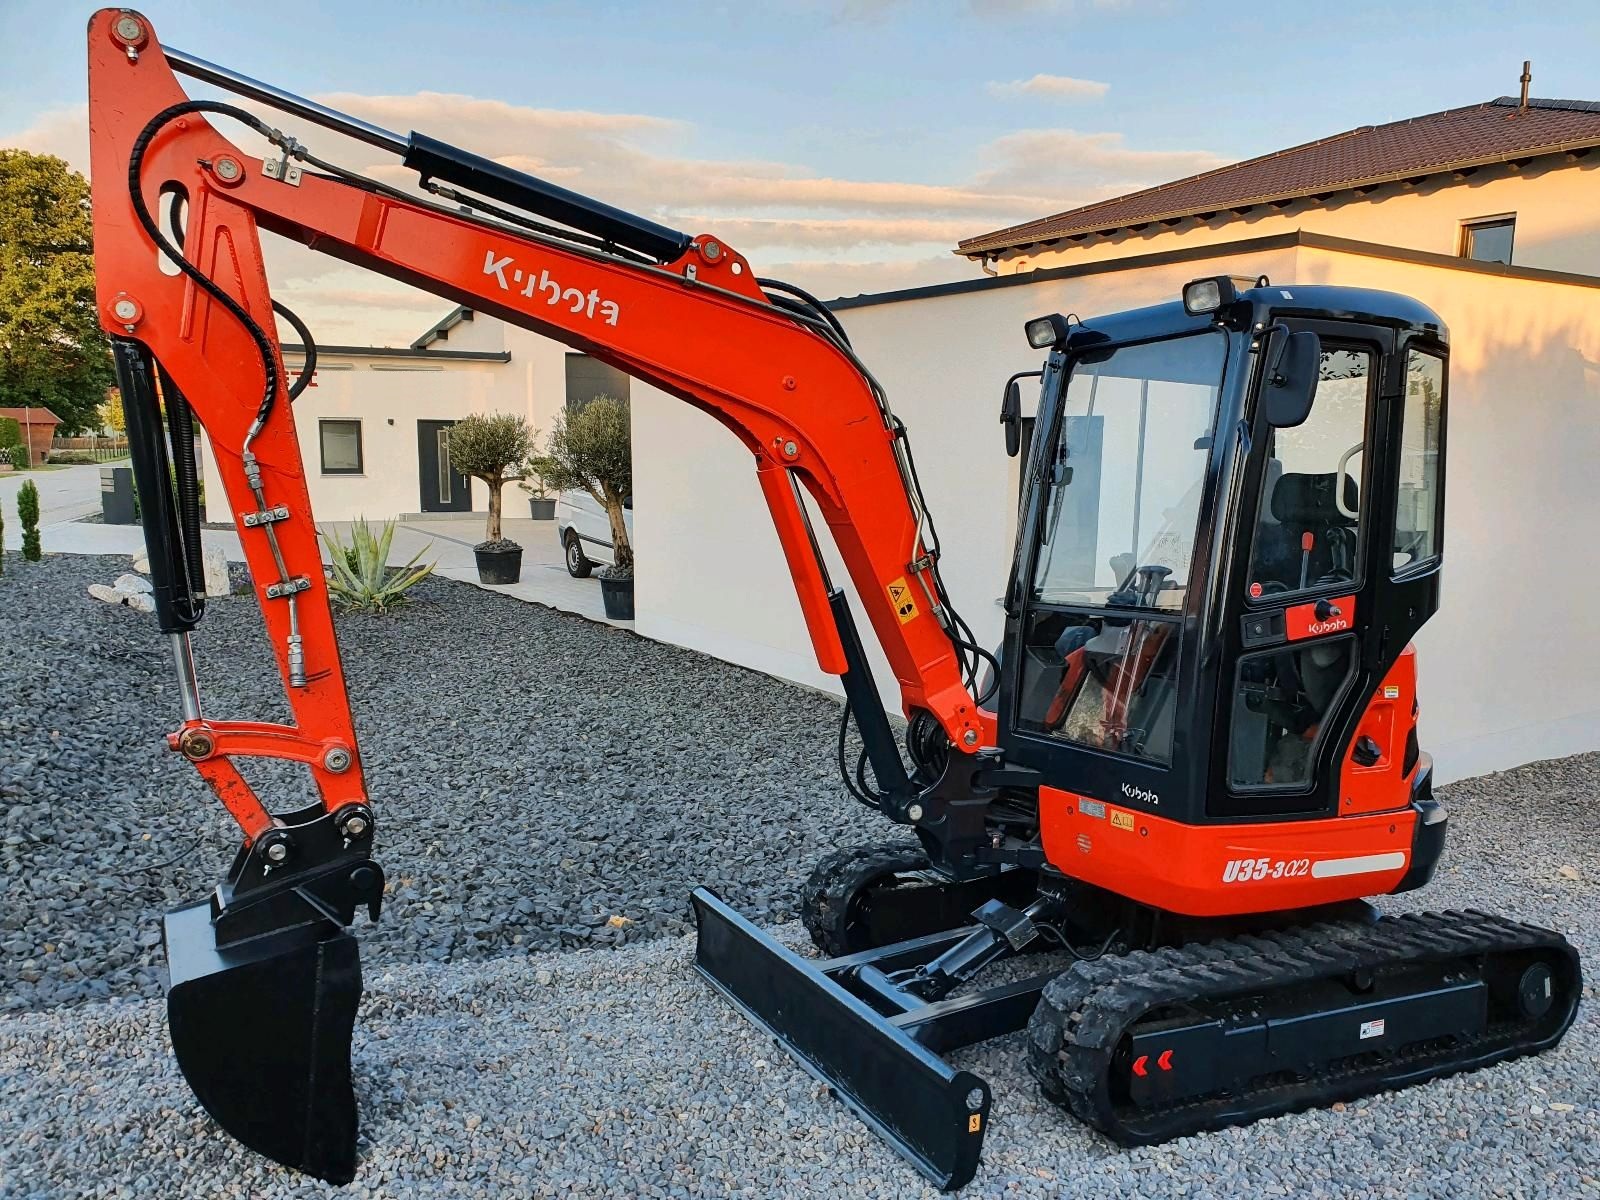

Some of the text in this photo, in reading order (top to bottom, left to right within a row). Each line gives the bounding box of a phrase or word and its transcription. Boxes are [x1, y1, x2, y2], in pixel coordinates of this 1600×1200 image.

[483, 250, 619, 326] Kubota
[1308, 619, 1347, 633] Kubota
[1121, 782, 1159, 805] Kubota
